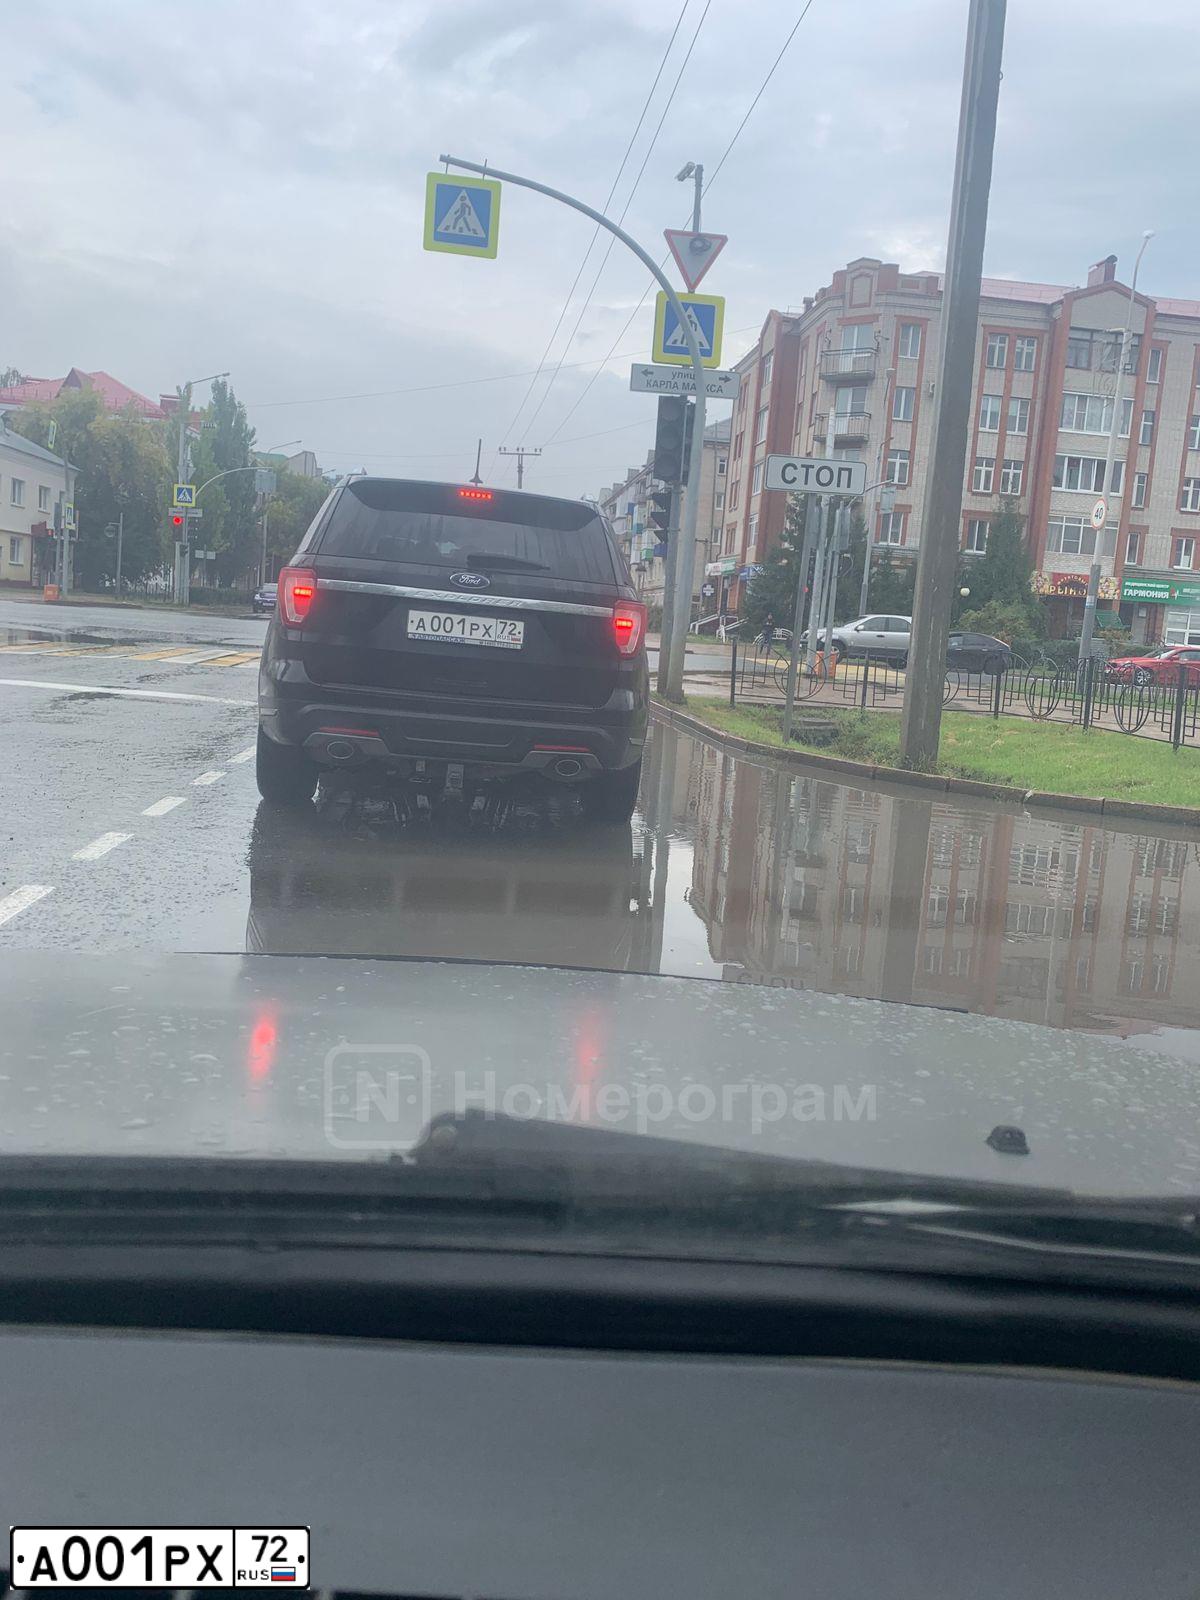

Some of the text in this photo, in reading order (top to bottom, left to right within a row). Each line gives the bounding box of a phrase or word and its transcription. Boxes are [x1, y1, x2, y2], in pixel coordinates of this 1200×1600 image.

[671, 370, 696, 380] улиц
[646, 379, 724, 394] КАРЛА МАКСА
[781, 462, 853, 489] СТОП
[1094, 507, 1104, 519] 40
[459, 574, 481, 585] Ford
[1049, 585, 1087, 596] РЫНО
[1123, 588, 1169, 599] ГАРМОНИЯ
[499, 621, 517, 635] 72
